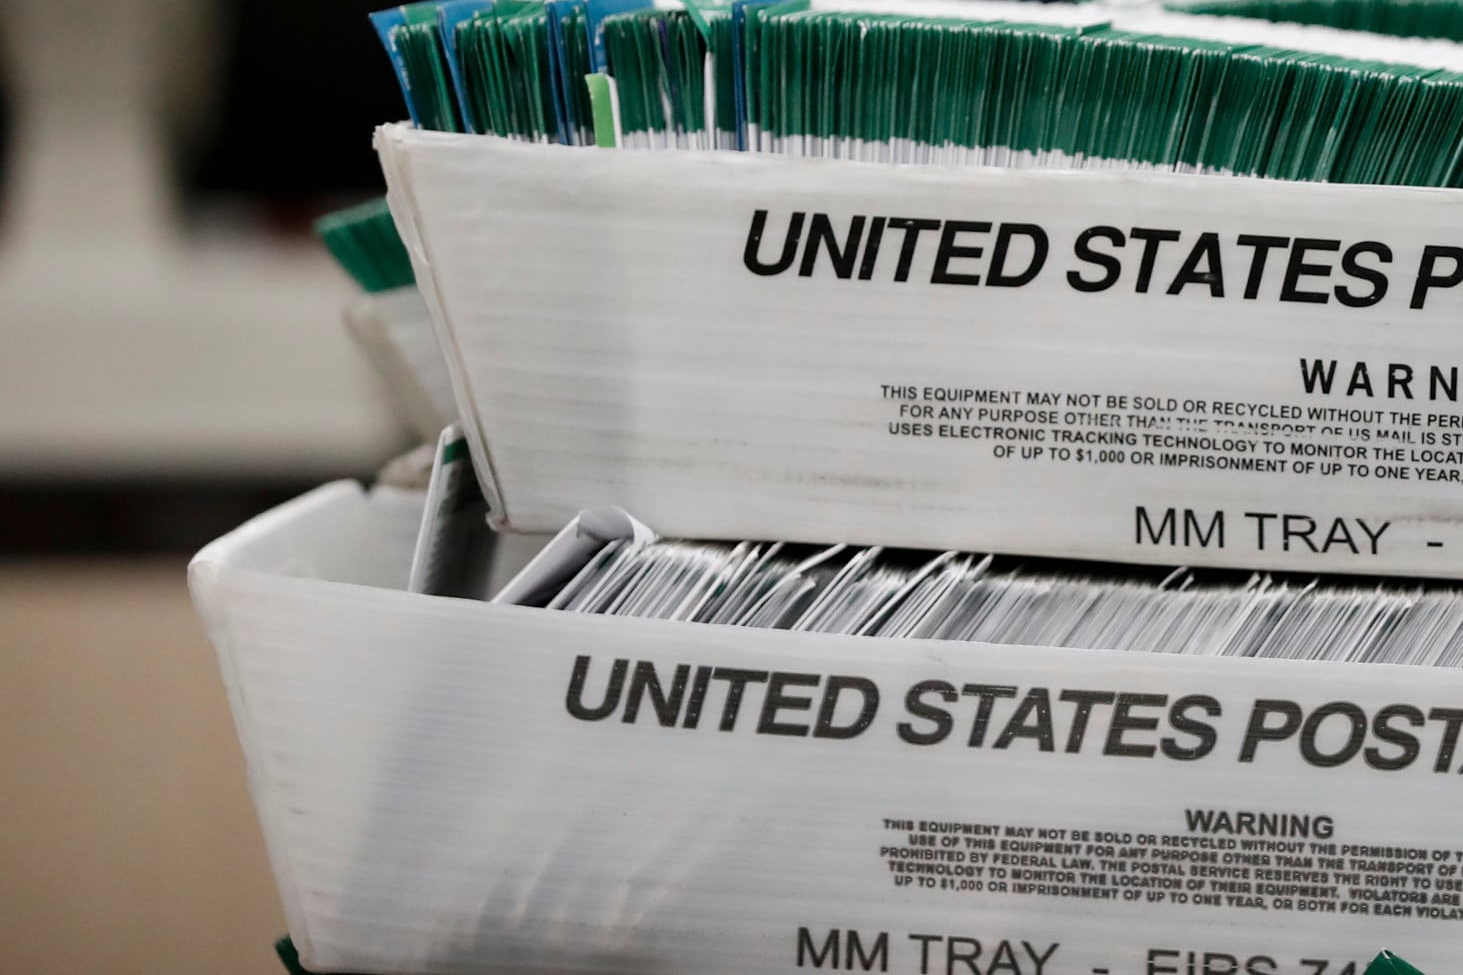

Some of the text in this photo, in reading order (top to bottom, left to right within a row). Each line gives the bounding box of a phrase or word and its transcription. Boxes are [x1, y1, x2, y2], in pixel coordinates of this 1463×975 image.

[744, 210, 1049, 287] UNITED
[1067, 226, 1393, 307] STATES
[881, 385, 917, 401] THIS
[923, 387, 1021, 404] EQUIPMENT
[1027, 392, 1061, 405] MAY
[1067, 394, 1101, 407] NOT
[1106, 395, 1127, 409] BE
[1133, 396, 1177, 411] SOLD
[1183, 400, 1206, 414] OR
[1212, 401, 1302, 419] RECYCLED
[1307, 407, 1384, 424] WITHOUT
[1389, 412, 1421, 426] THE
[900, 404, 934, 418] FOR
[938, 407, 973, 420] ANY
[978, 408, 1058, 424] PURPOSE
[1064, 412, 1121, 427] OTHER
[1421, 432, 1436, 445] IS
[889, 422, 933, 436] USES
[939, 425, 1045, 441] ELECTRONIC
[1051, 429, 1137, 446] TRACKING
[1142, 434, 1258, 452] TECHNOLOGY
[1263, 441, 1285, 454] TO
[1290, 443, 1367, 459] MONITOR
[1373, 447, 1405, 461] THE
[993, 445, 1016, 458] OF
[1021, 446, 1043, 459] UP
[1049, 447, 1071, 461] TO
[1076, 448, 1125, 464] $1,000
[1130, 451, 1154, 465] OR
[1160, 453, 1288, 473] IMPRISONMENT
[1292, 461, 1315, 474] OF
[1320, 462, 1342, 475] UP
[1347, 464, 1369, 477] TO
[1374, 465, 1410, 480] ONE
[1415, 468, 1463, 484] YEAR,
[1136, 506, 1224, 548] MM
[1245, 513, 1390, 554] TRAY
[1426, 540, 1445, 549] -
[566, 655, 880, 739] UNITED
[897, 680, 1221, 761] STATES
[882, 818, 914, 831] THIS
[918, 821, 1000, 836] EQUIPMENT
[1004, 826, 1034, 838] MAY
[1038, 828, 1067, 840] NOT
[1071, 830, 1090, 842] BE
[1094, 831, 1132, 844] SOLD
[1136, 834, 1157, 846] OR
[1161, 835, 1237, 850] RECYCLED
[1240, 839, 1305, 853] WITHOUT
[1309, 842, 1337, 856] THE
[1341, 844, 1428, 860] PERMISSION
[1181, 810, 1333, 840] WARNING
[879, 846, 966, 862] PROHIBITED
[969, 851, 989, 863] BY
[992, 853, 1057, 868] FEDERAL
[1099, 859, 1127, 873] THE
[1131, 861, 1186, 876] POSTAL
[1190, 865, 1250, 879] SERVICE
[1254, 868, 1329, 884] RESERVES
[1333, 872, 1361, 886] THE
[1365, 874, 1408, 888] RIGHT
[1411, 876, 1432, 890] TO
[1435, 878, 1463, 892] USE
[908, 834, 1271, 866] USE OF THIS EQUIPMENT FOR PURPOSE OTHER
[894, 875, 913, 887] UP
[917, 876, 936, 888] TO
[940, 877, 984, 892] $1,000
[987, 881, 1008, 893] OR
[1012, 883, 1119, 899] IMPRISONMENT
[1123, 889, 1142, 901] OF
[1146, 891, 1165, 903] UP
[1169, 892, 1188, 904] TO
[1192, 893, 1222, 907] ONE
[1273, 898, 1293, 910] OR
[1297, 899, 1336, 913] BOTH
[1373, 903, 1412, 917] EACH
[988, 866, 1007, 879] TO
[1011, 868, 1076, 884] MONITOR
[1111, 874, 1183, 890] LOCATION
[1186, 879, 1205, 891] OF
[1210, 880, 1252, 894] THEIR
[796, 927, 889, 972] MM
[909, 934, 1059, 975] TRAY
[1147, 949, 1277, 975] EIRS
